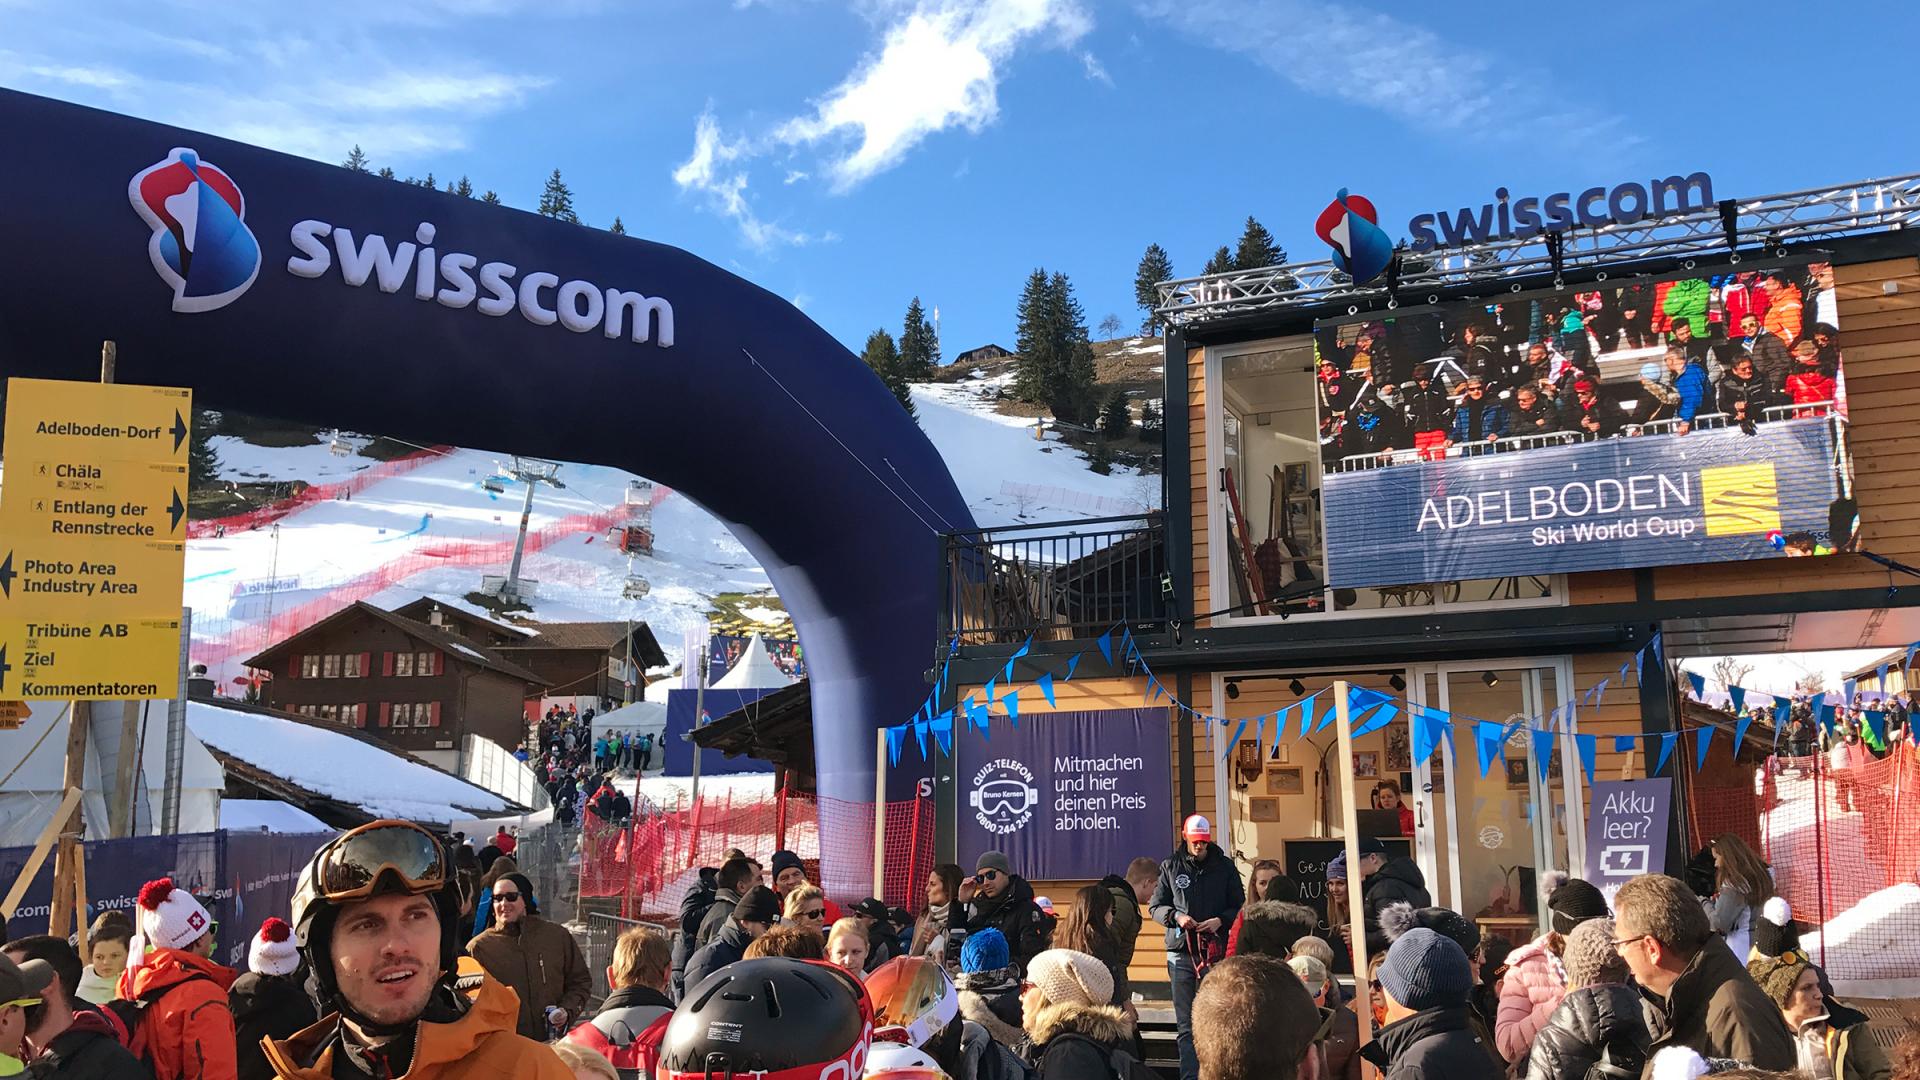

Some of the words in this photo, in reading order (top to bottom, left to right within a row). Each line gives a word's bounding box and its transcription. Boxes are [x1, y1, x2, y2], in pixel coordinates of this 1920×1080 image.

[1409, 172, 1714, 250] swisscom
[287, 219, 675, 348] swisscom
[36, 421, 161, 439] Adelboden-Dorf
[55, 464, 102, 479] Chäla
[53, 500, 116, 518] Entlang
[120, 502, 148, 516] der
[1416, 472, 1691, 532] ADELBODEN
[52, 520, 154, 536] Rennstrecke
[1532, 526, 1566, 546] Ski
[1572, 519, 1638, 543] World
[1646, 515, 1695, 538] Cup
[24, 560, 74, 575] Photo
[78, 562, 116, 575] Area
[23, 579, 95, 596] Industry
[100, 580, 138, 594] Area
[26, 624, 91, 637] Tribüne
[100, 624, 128, 637] AB
[24, 652, 55, 666] Ziel
[22, 682, 157, 696] Kommentatoren
[973, 758, 1034, 786] QUIZ-TELEFON
[1054, 753, 1143, 773] Mitmachen
[1055, 774, 1085, 792] und
[1089, 773, 1118, 791] hier
[1054, 794, 1106, 811] deinen
[1111, 792, 1146, 810] Preis
[1602, 790, 1655, 815] Akku
[975, 812, 997, 832] 0800
[997, 823, 1017, 834] 244
[1015, 810, 1032, 829] 244
[1055, 812, 1121, 831] abholen.
[1603, 815, 1651, 839] leer?
[710, 1021, 744, 1029] CONTENT
